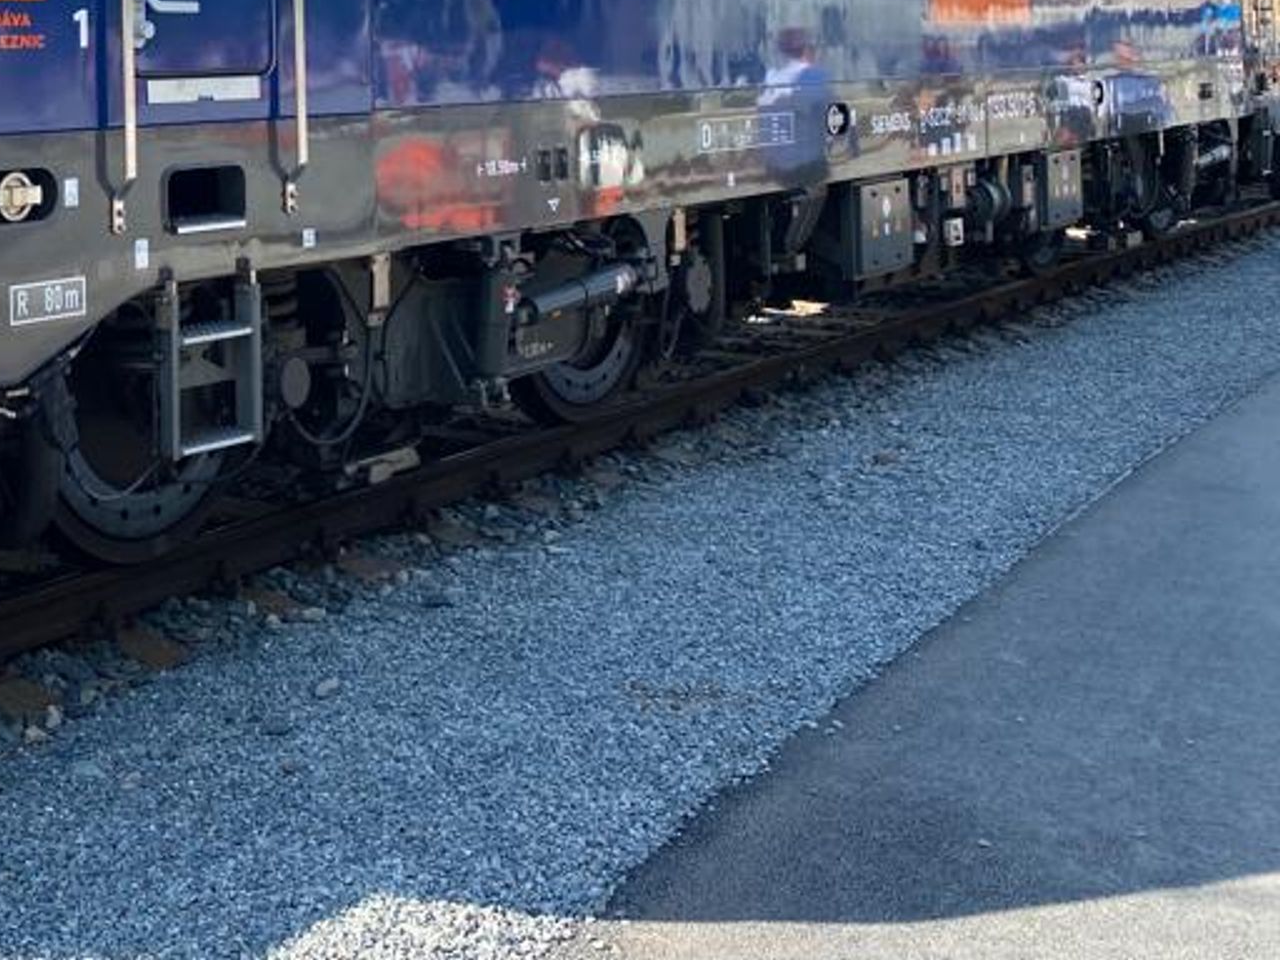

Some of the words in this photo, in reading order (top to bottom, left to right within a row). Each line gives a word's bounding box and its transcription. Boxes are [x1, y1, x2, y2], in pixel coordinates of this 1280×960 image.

[73, 7, 89, 49] 1
[16, 289, 29, 317] R
[44, 284, 80, 313] 80m
